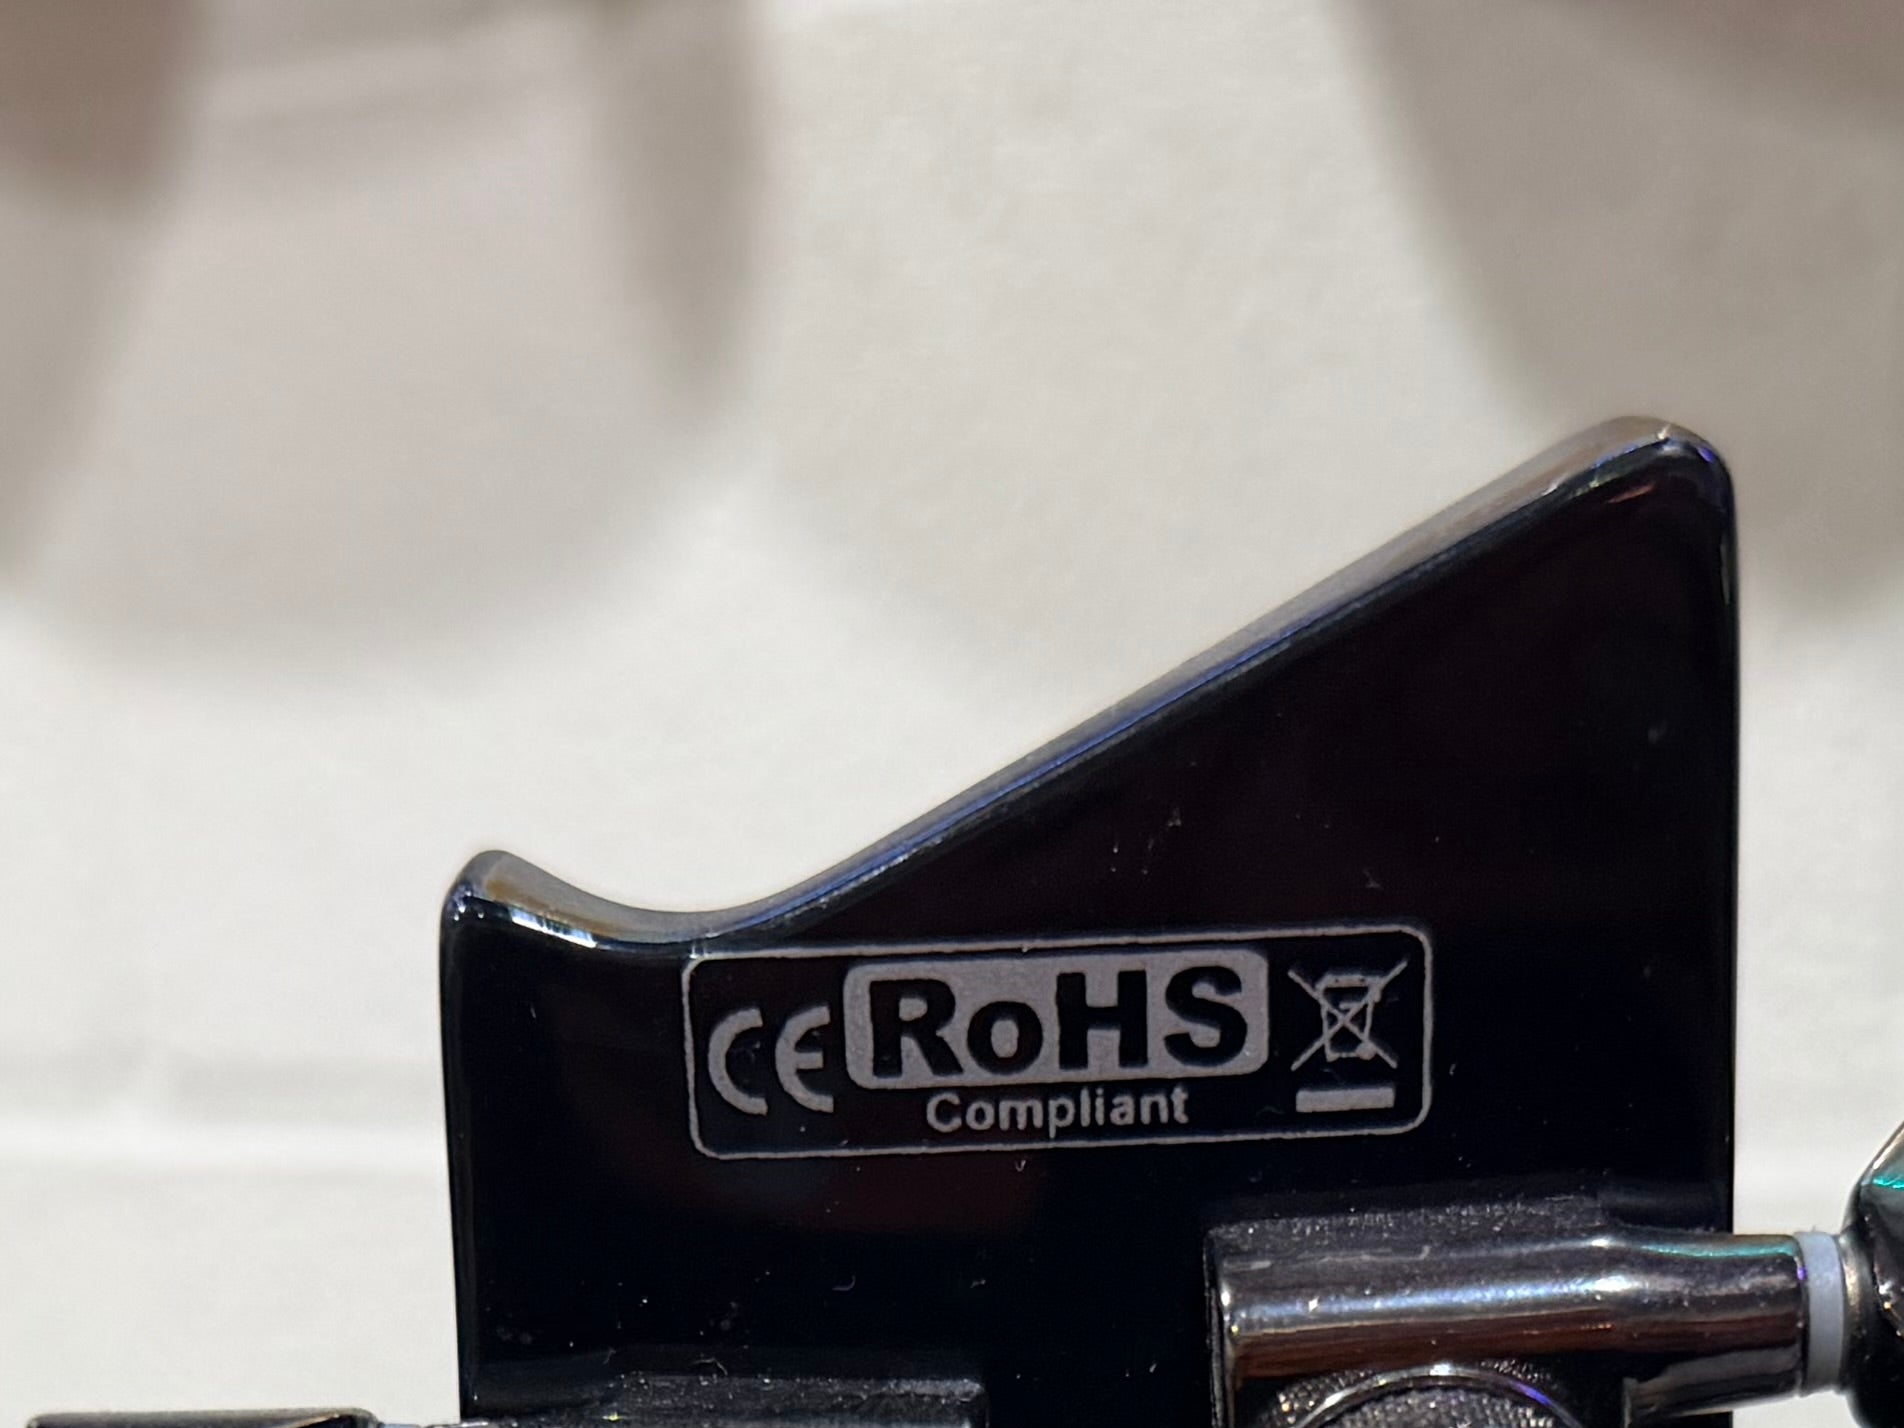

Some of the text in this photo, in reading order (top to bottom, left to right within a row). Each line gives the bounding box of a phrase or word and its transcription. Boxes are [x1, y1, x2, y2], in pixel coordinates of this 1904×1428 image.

[707, 1004, 836, 1116] CE
[867, 965, 1251, 1079] RoHS
[925, 1084, 1190, 1139] Compliant
